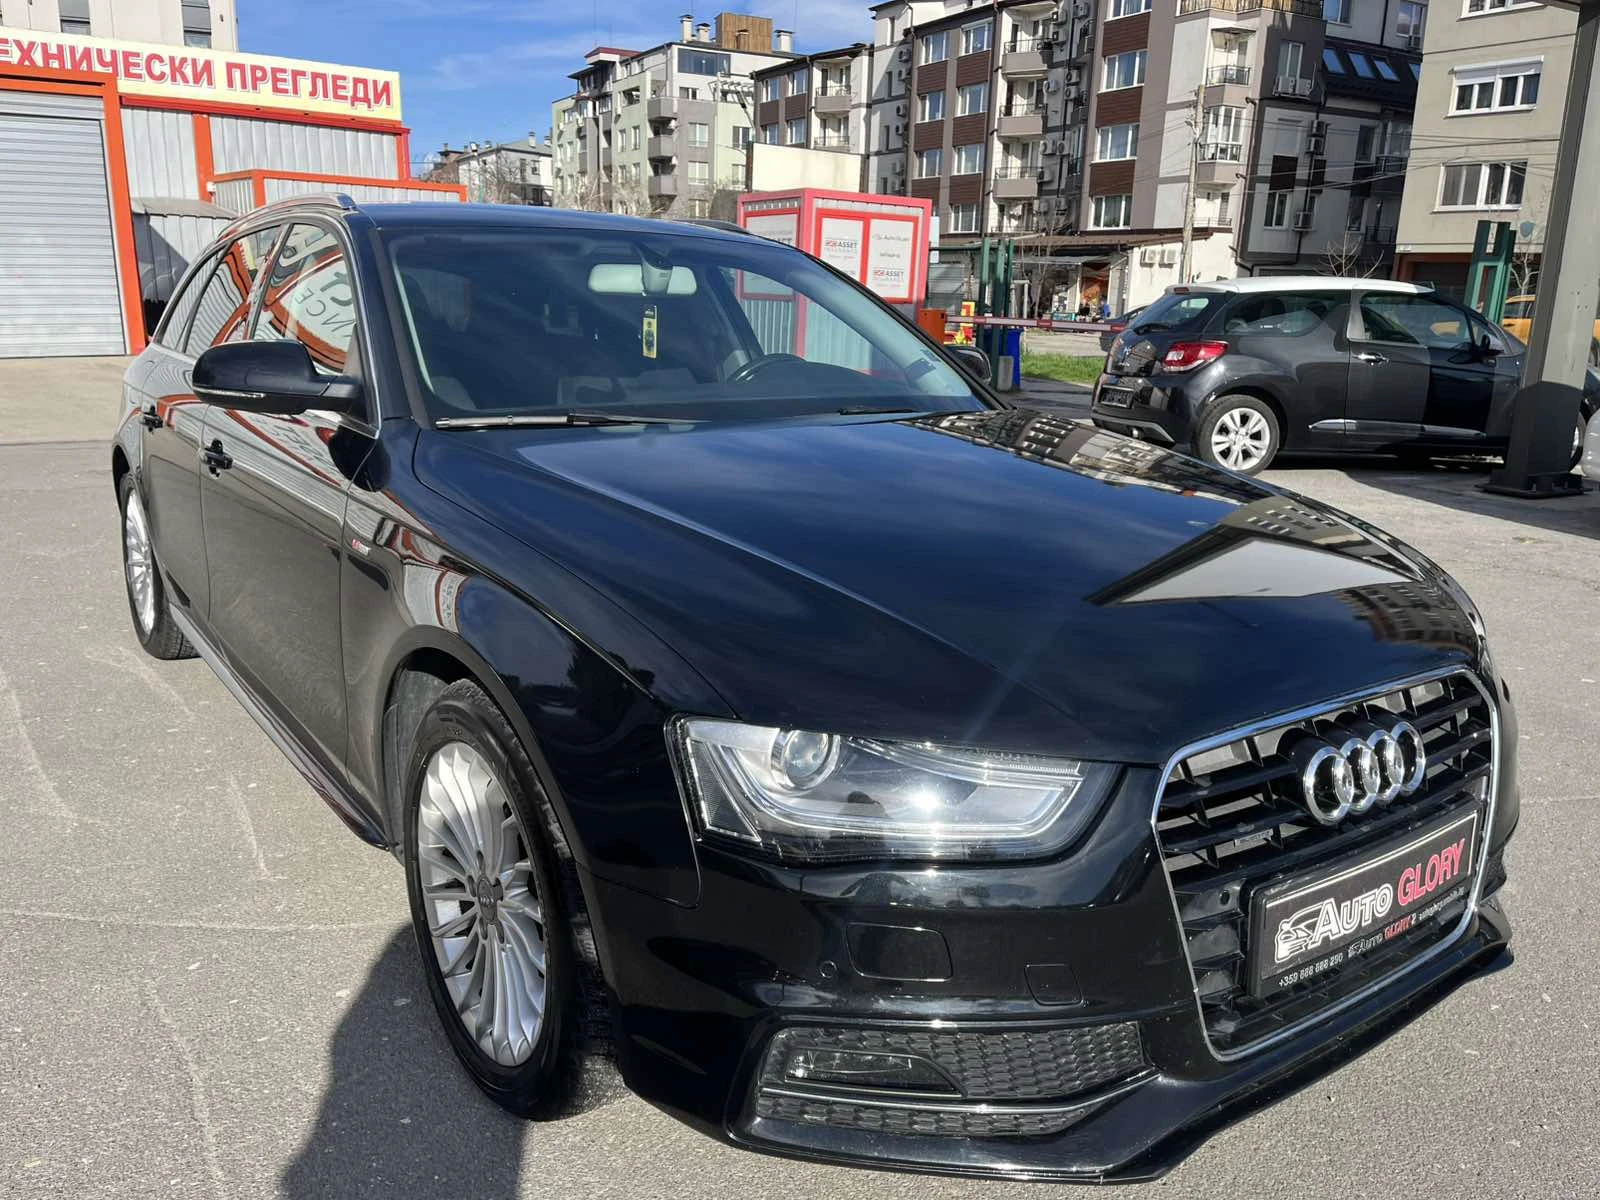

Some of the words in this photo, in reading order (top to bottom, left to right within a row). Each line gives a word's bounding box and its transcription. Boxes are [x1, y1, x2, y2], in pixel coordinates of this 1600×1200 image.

[226, 63, 392, 109] ПРЕГЛЕДИ
[839, 240, 857, 249] ASSET
[885, 270, 904, 278] ASSET
[1308, 883, 1394, 949] AUTO
[1397, 838, 1466, 907] GLORY
[1278, 971, 1299, 988] +359
